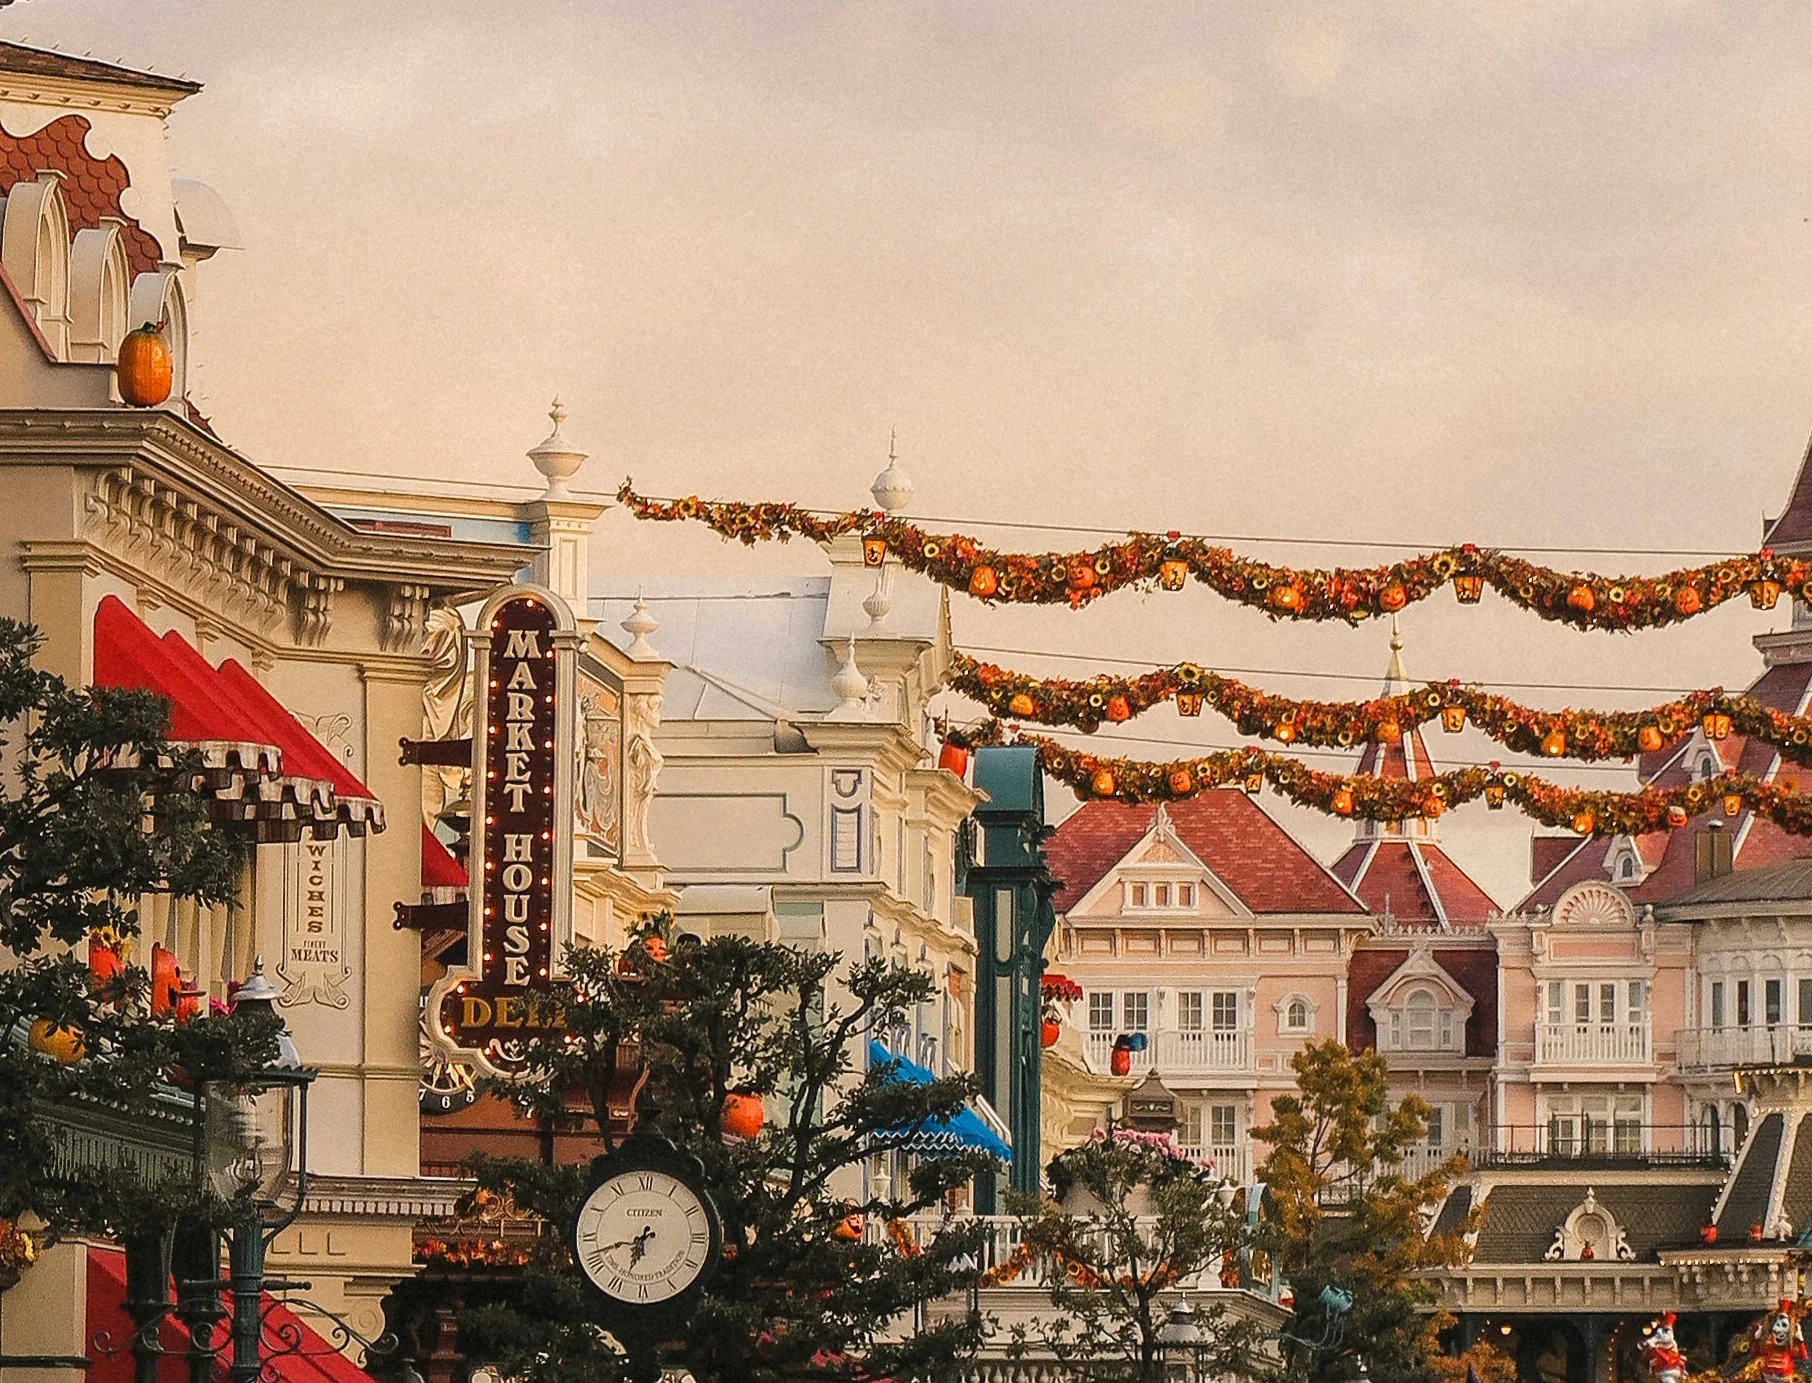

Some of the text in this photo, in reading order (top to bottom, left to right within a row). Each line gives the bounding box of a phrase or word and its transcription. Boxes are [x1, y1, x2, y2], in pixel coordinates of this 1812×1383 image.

[503, 630, 541, 986] MARKET HOUSE
[306, 831, 326, 933] WICHES
[291, 949, 339, 963] MEATS
[461, 997, 568, 1028] DELI
[441, 1096, 451, 1109] 6
[626, 1208, 663, 1217] CITIZEN
